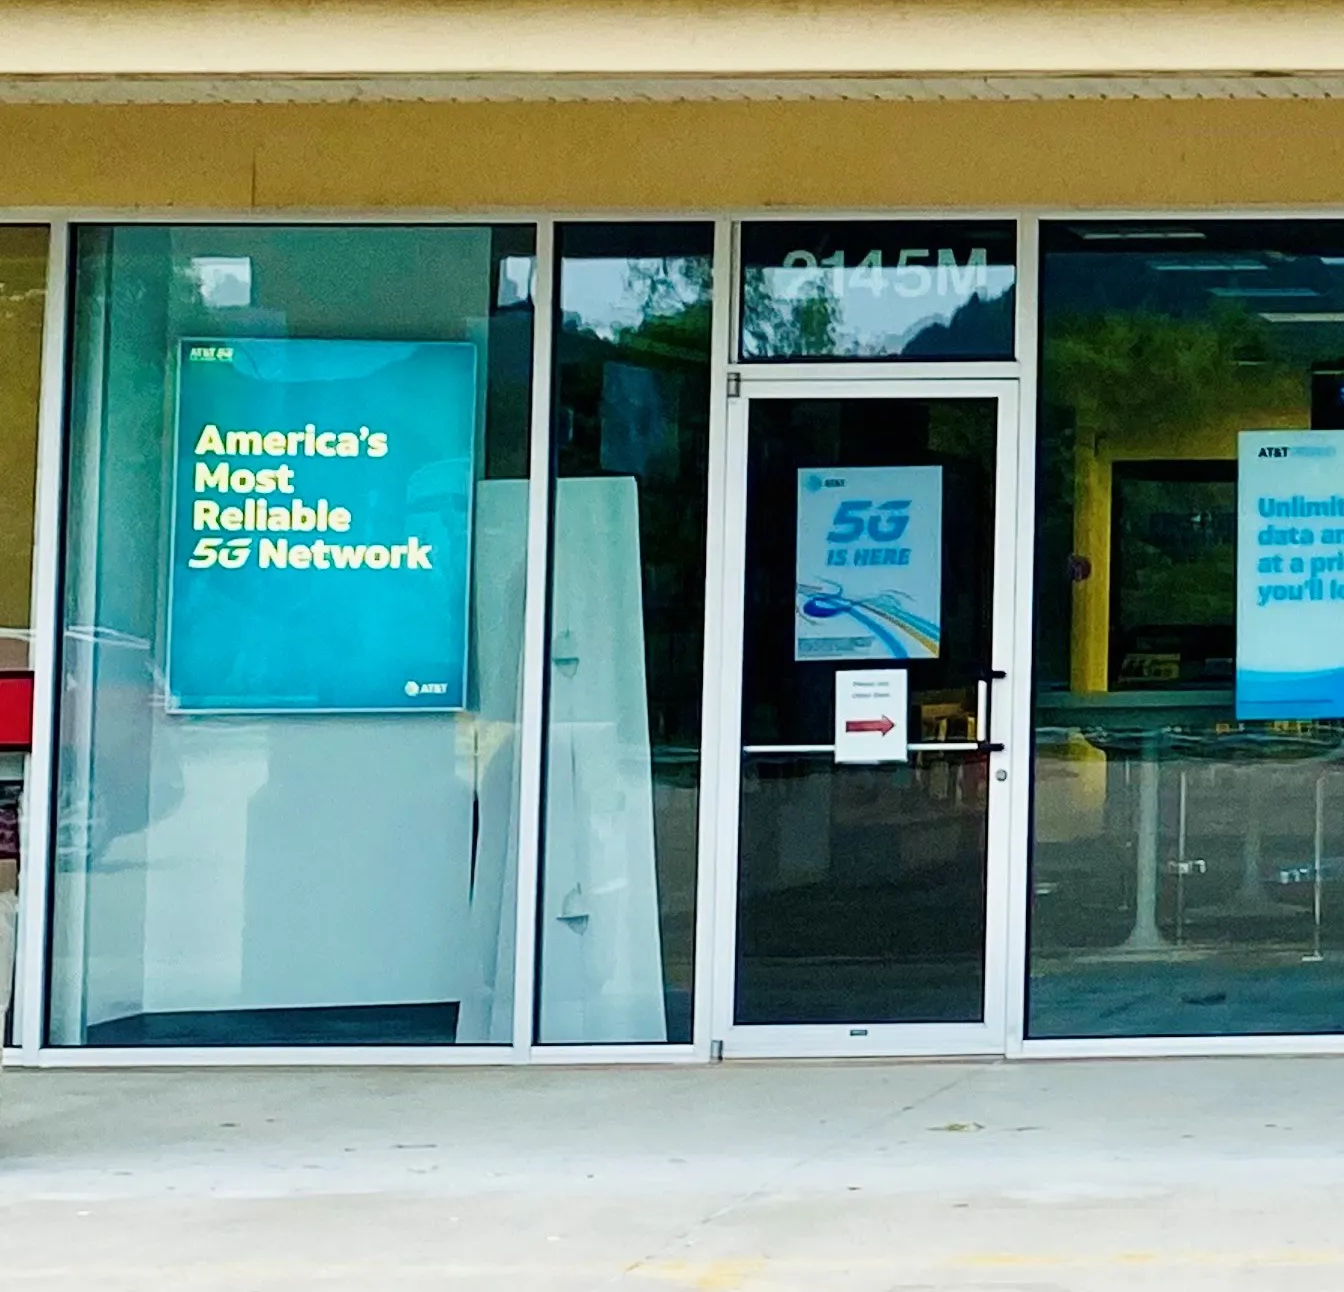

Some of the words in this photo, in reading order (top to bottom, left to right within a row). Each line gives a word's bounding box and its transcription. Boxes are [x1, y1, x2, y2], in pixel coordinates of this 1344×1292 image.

[782, 248, 988, 297] 2145M
[194, 423, 389, 457] America's
[1258, 447, 1289, 458] AT&T
[194, 462, 295, 494] Most
[193, 498, 351, 532] Reliable
[826, 500, 912, 542] 5G
[1258, 524, 1315, 546] data
[188, 538, 253, 569] 5G
[258, 536, 433, 569] Network
[826, 549, 848, 566] IS
[853, 548, 912, 566] HERE
[1258, 554, 1284, 573] at
[1289, 556, 1305, 573] a
[1258, 578, 1323, 607] you'll
